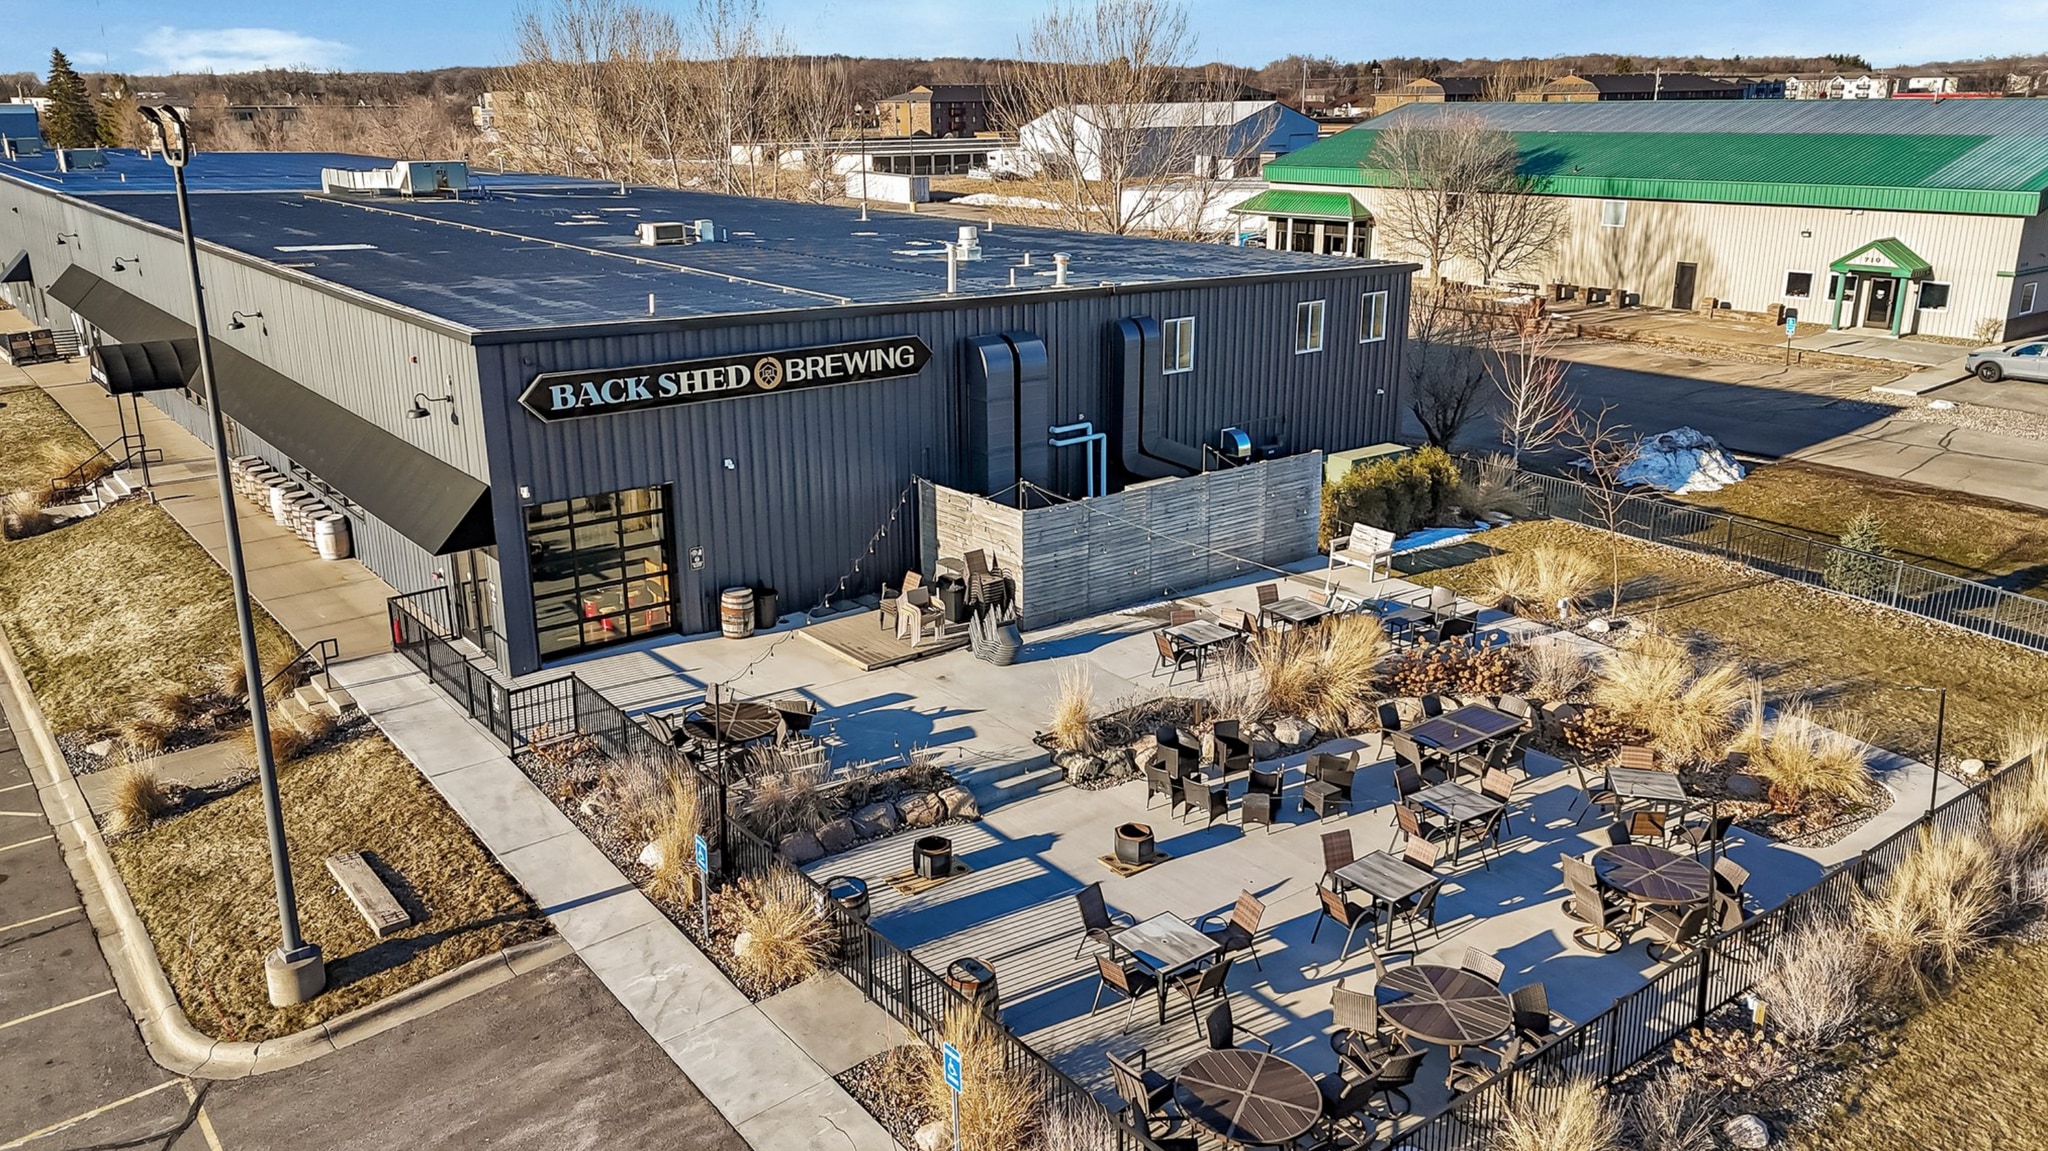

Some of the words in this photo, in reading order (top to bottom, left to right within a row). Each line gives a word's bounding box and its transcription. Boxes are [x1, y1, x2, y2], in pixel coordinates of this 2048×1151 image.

[549, 375, 653, 410] BACK
[658, 364, 751, 398] SHED
[786, 345, 915, 382] BREWING
